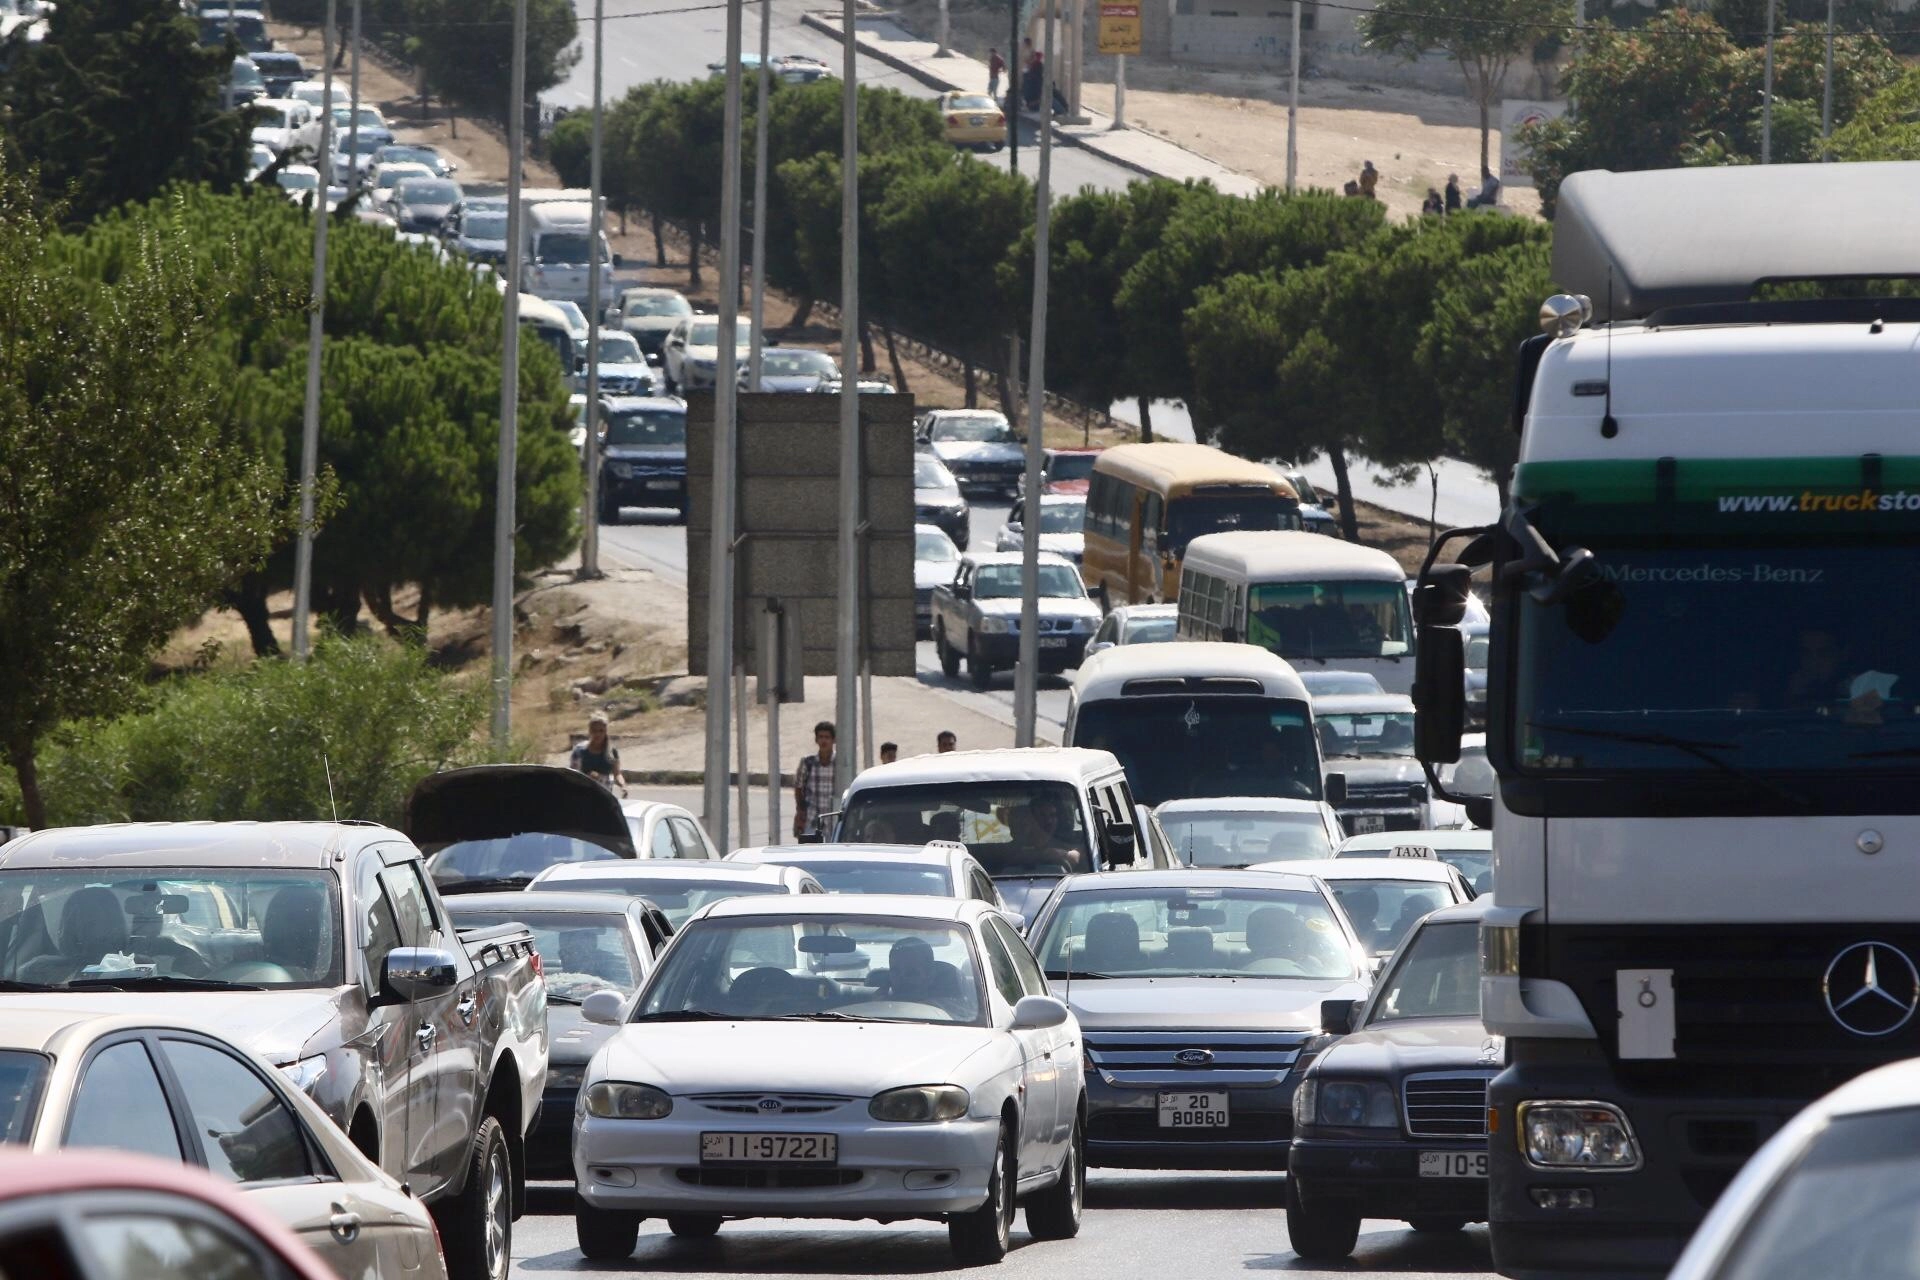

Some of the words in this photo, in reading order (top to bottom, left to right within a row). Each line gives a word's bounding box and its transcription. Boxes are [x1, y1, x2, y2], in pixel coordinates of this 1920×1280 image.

[1602, 564, 1825, 582] Mercedes-Benz
[1395, 846, 1428, 858] TAXI
[1182, 1051, 1205, 1061] Ford
[1189, 1095, 1209, 1109] 20
[1173, 1111, 1226, 1125] 80860
[729, 1136, 828, 1158] 11-97221
